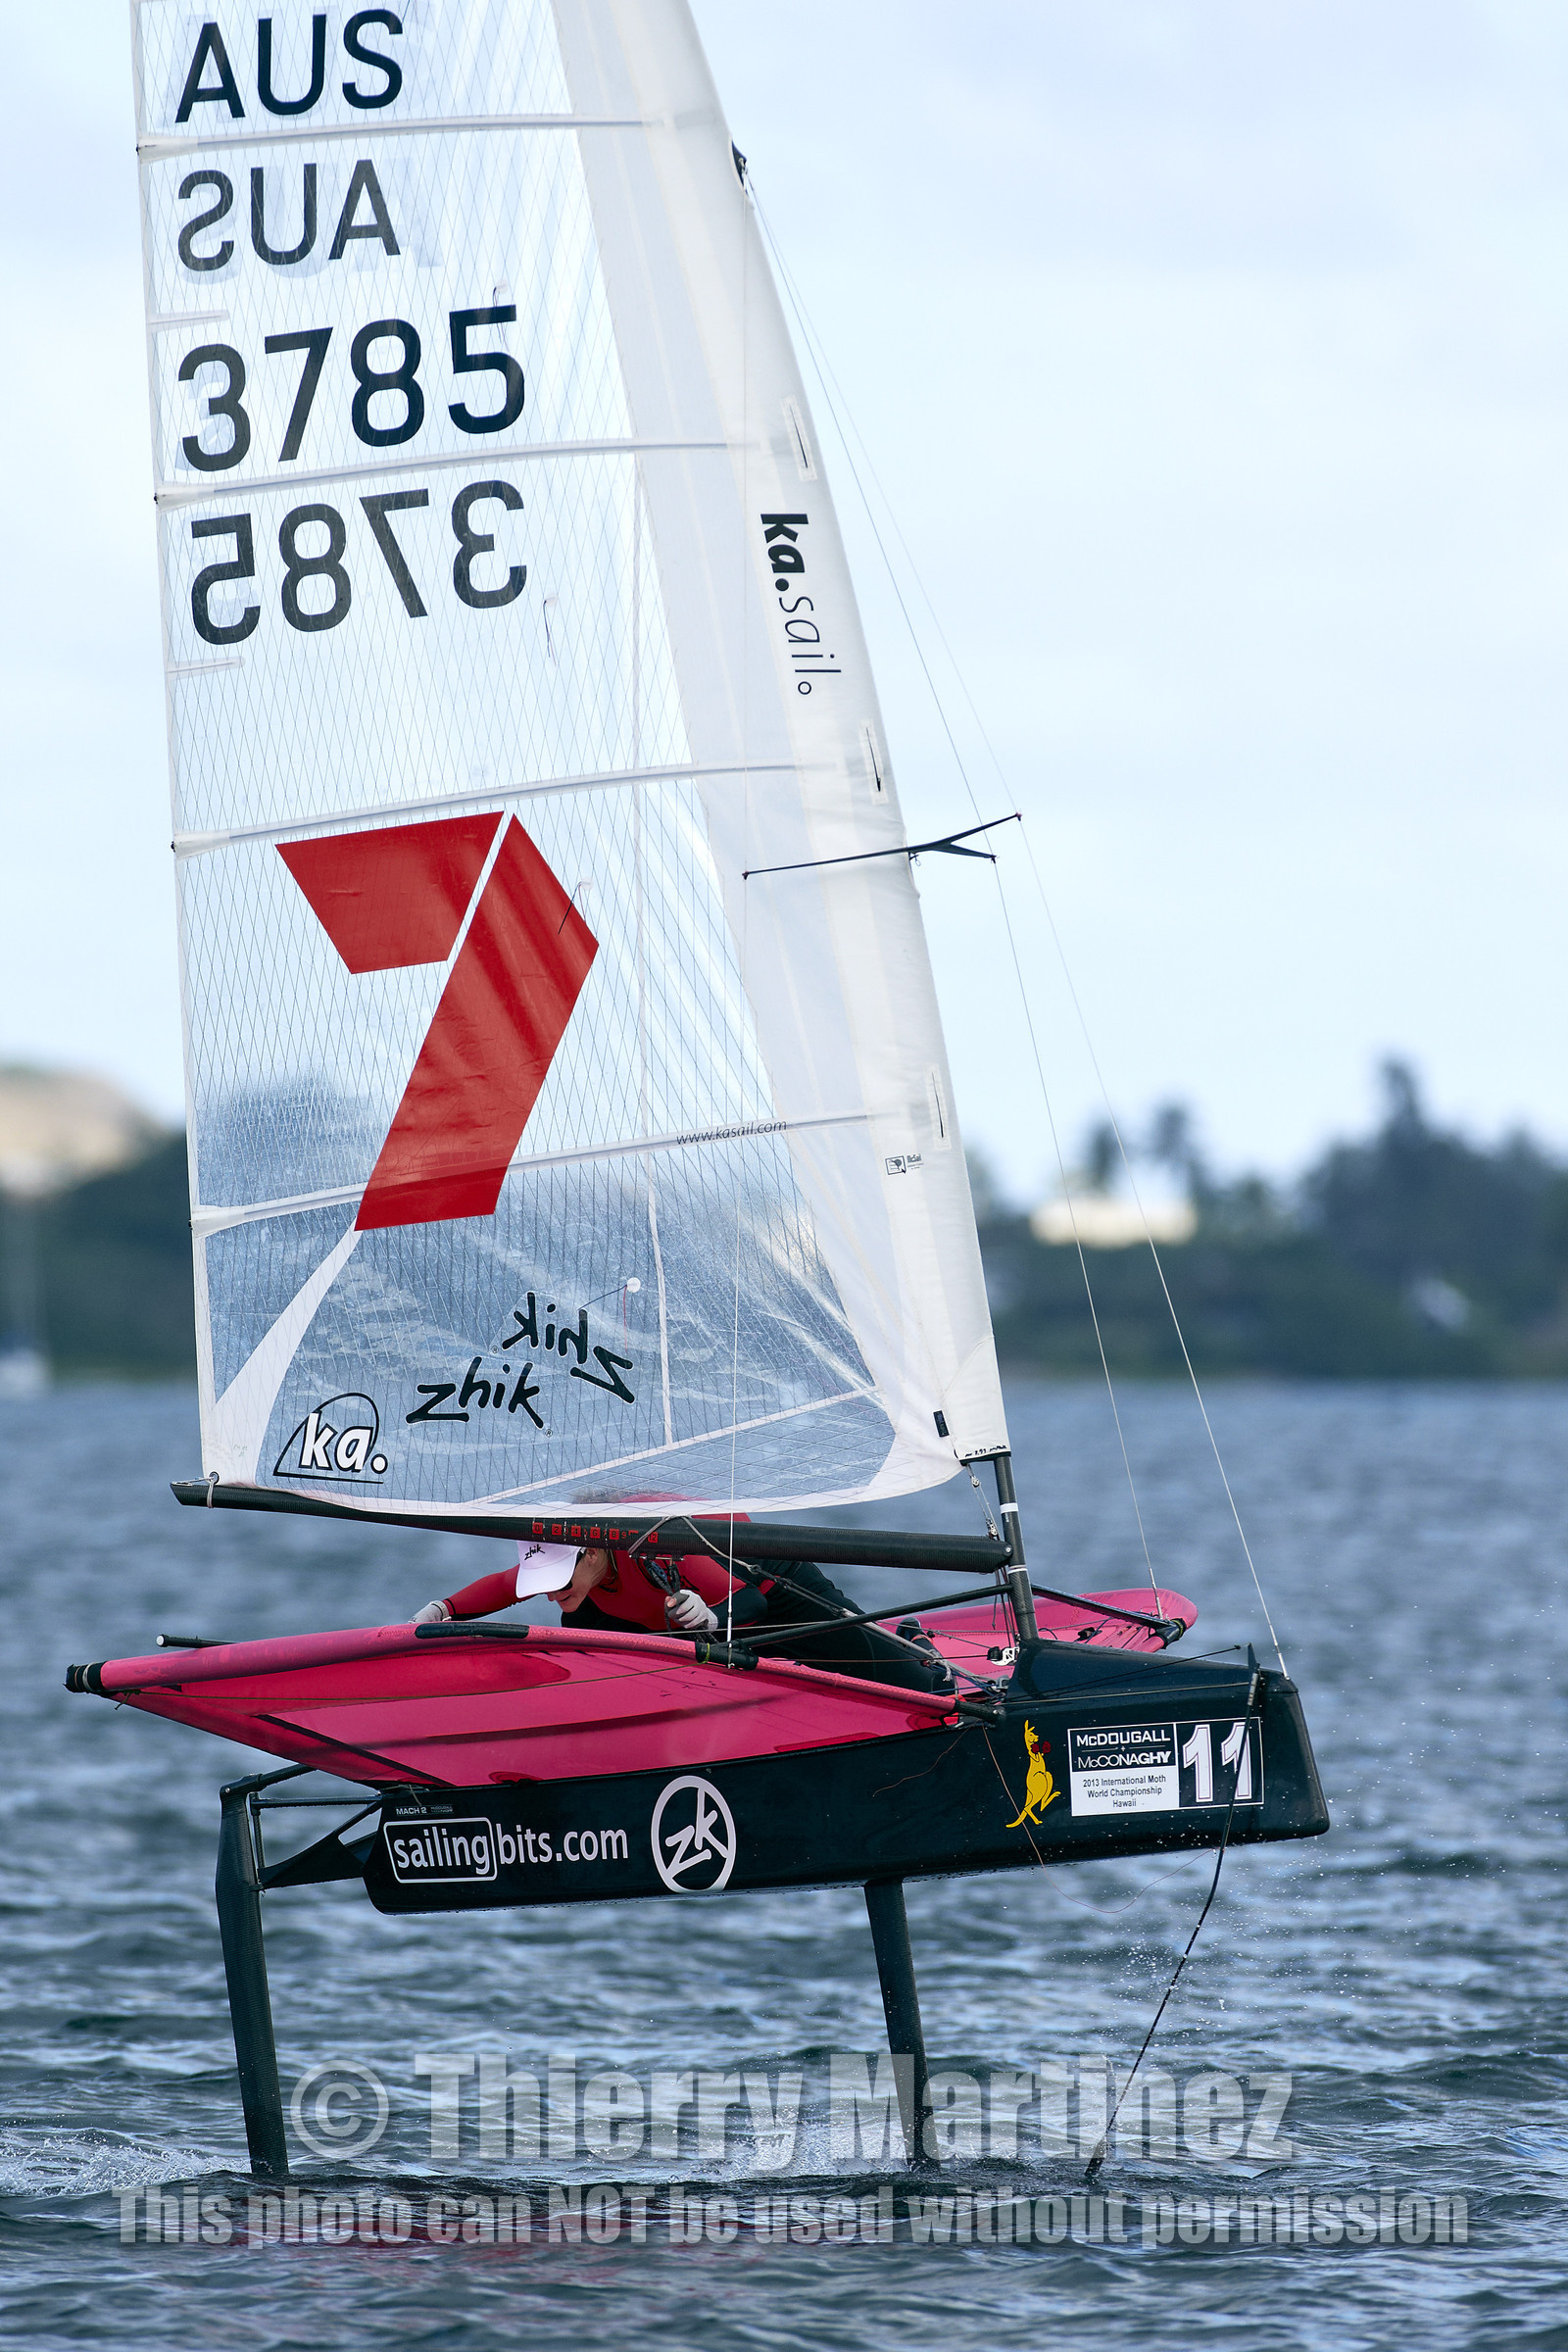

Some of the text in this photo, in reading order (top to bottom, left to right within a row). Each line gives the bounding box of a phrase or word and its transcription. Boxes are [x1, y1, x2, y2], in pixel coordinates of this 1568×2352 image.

[174, 9, 404, 123] AUS
[177, 304, 525, 472] 3785
[676, 1118, 787, 1146] www.kasail.com
[1076, 1730, 1170, 1746] McDOUGALL
[1078, 1751, 1171, 1769] McCONAGHY
[1182, 1722, 1252, 1803] 11
[1083, 1775, 1166, 1788] 2013 International Moth
[1087, 1786, 1162, 1797] World Championship
[1112, 1798, 1137, 1808] Hawaii
